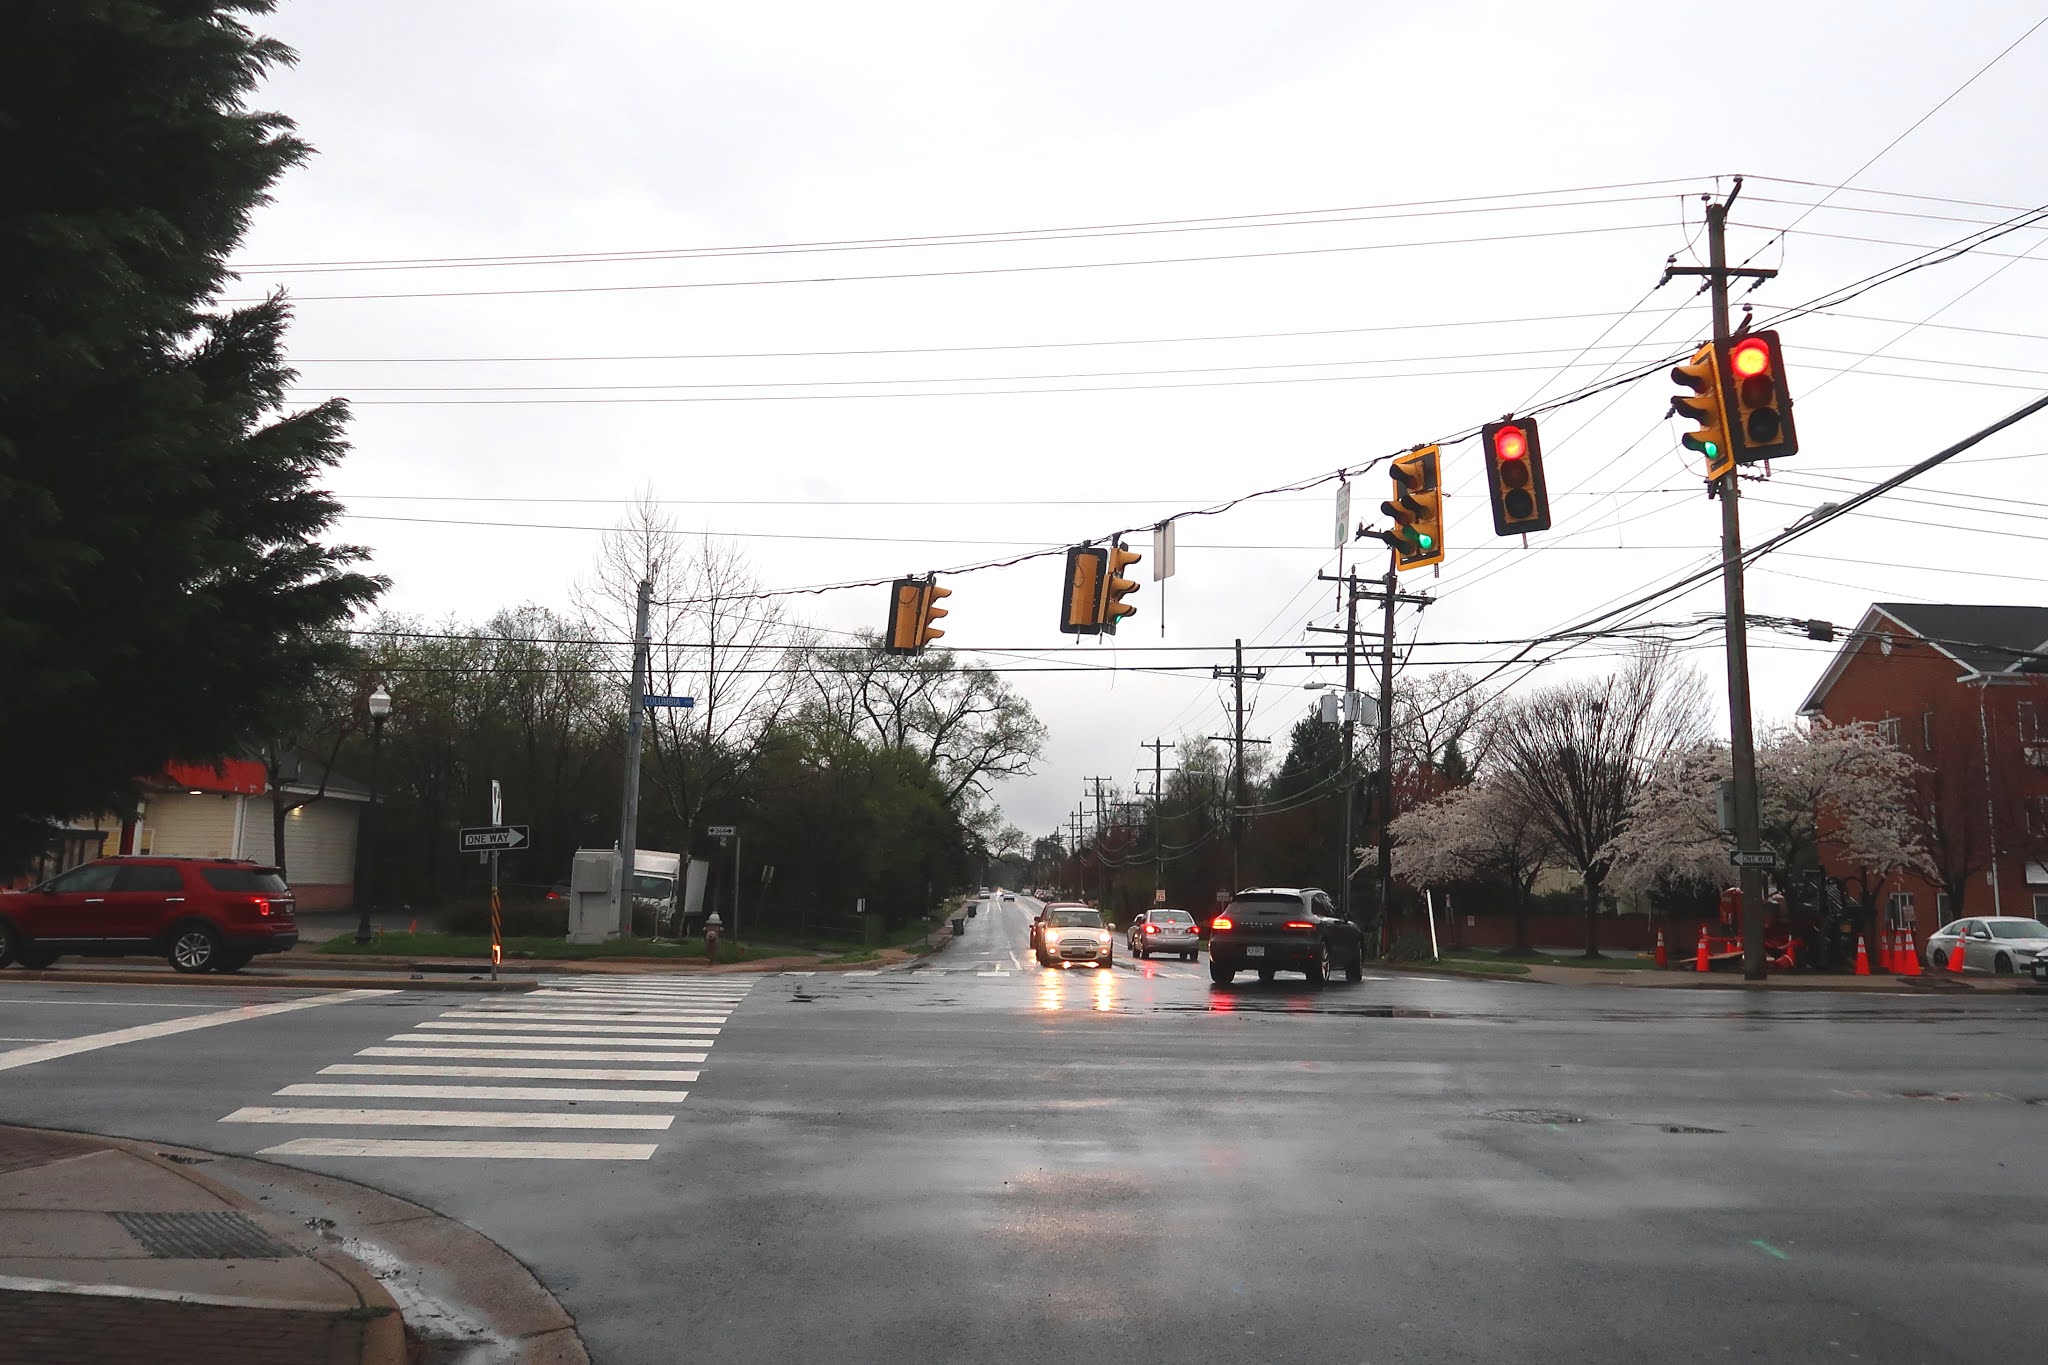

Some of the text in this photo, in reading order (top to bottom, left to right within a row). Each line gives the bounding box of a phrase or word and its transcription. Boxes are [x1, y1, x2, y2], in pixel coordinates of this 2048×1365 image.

[645, 697, 680, 705] COLUMBIA
[467, 833, 509, 844] ONE WAY
[1742, 855, 1771, 863] ONE WAY
